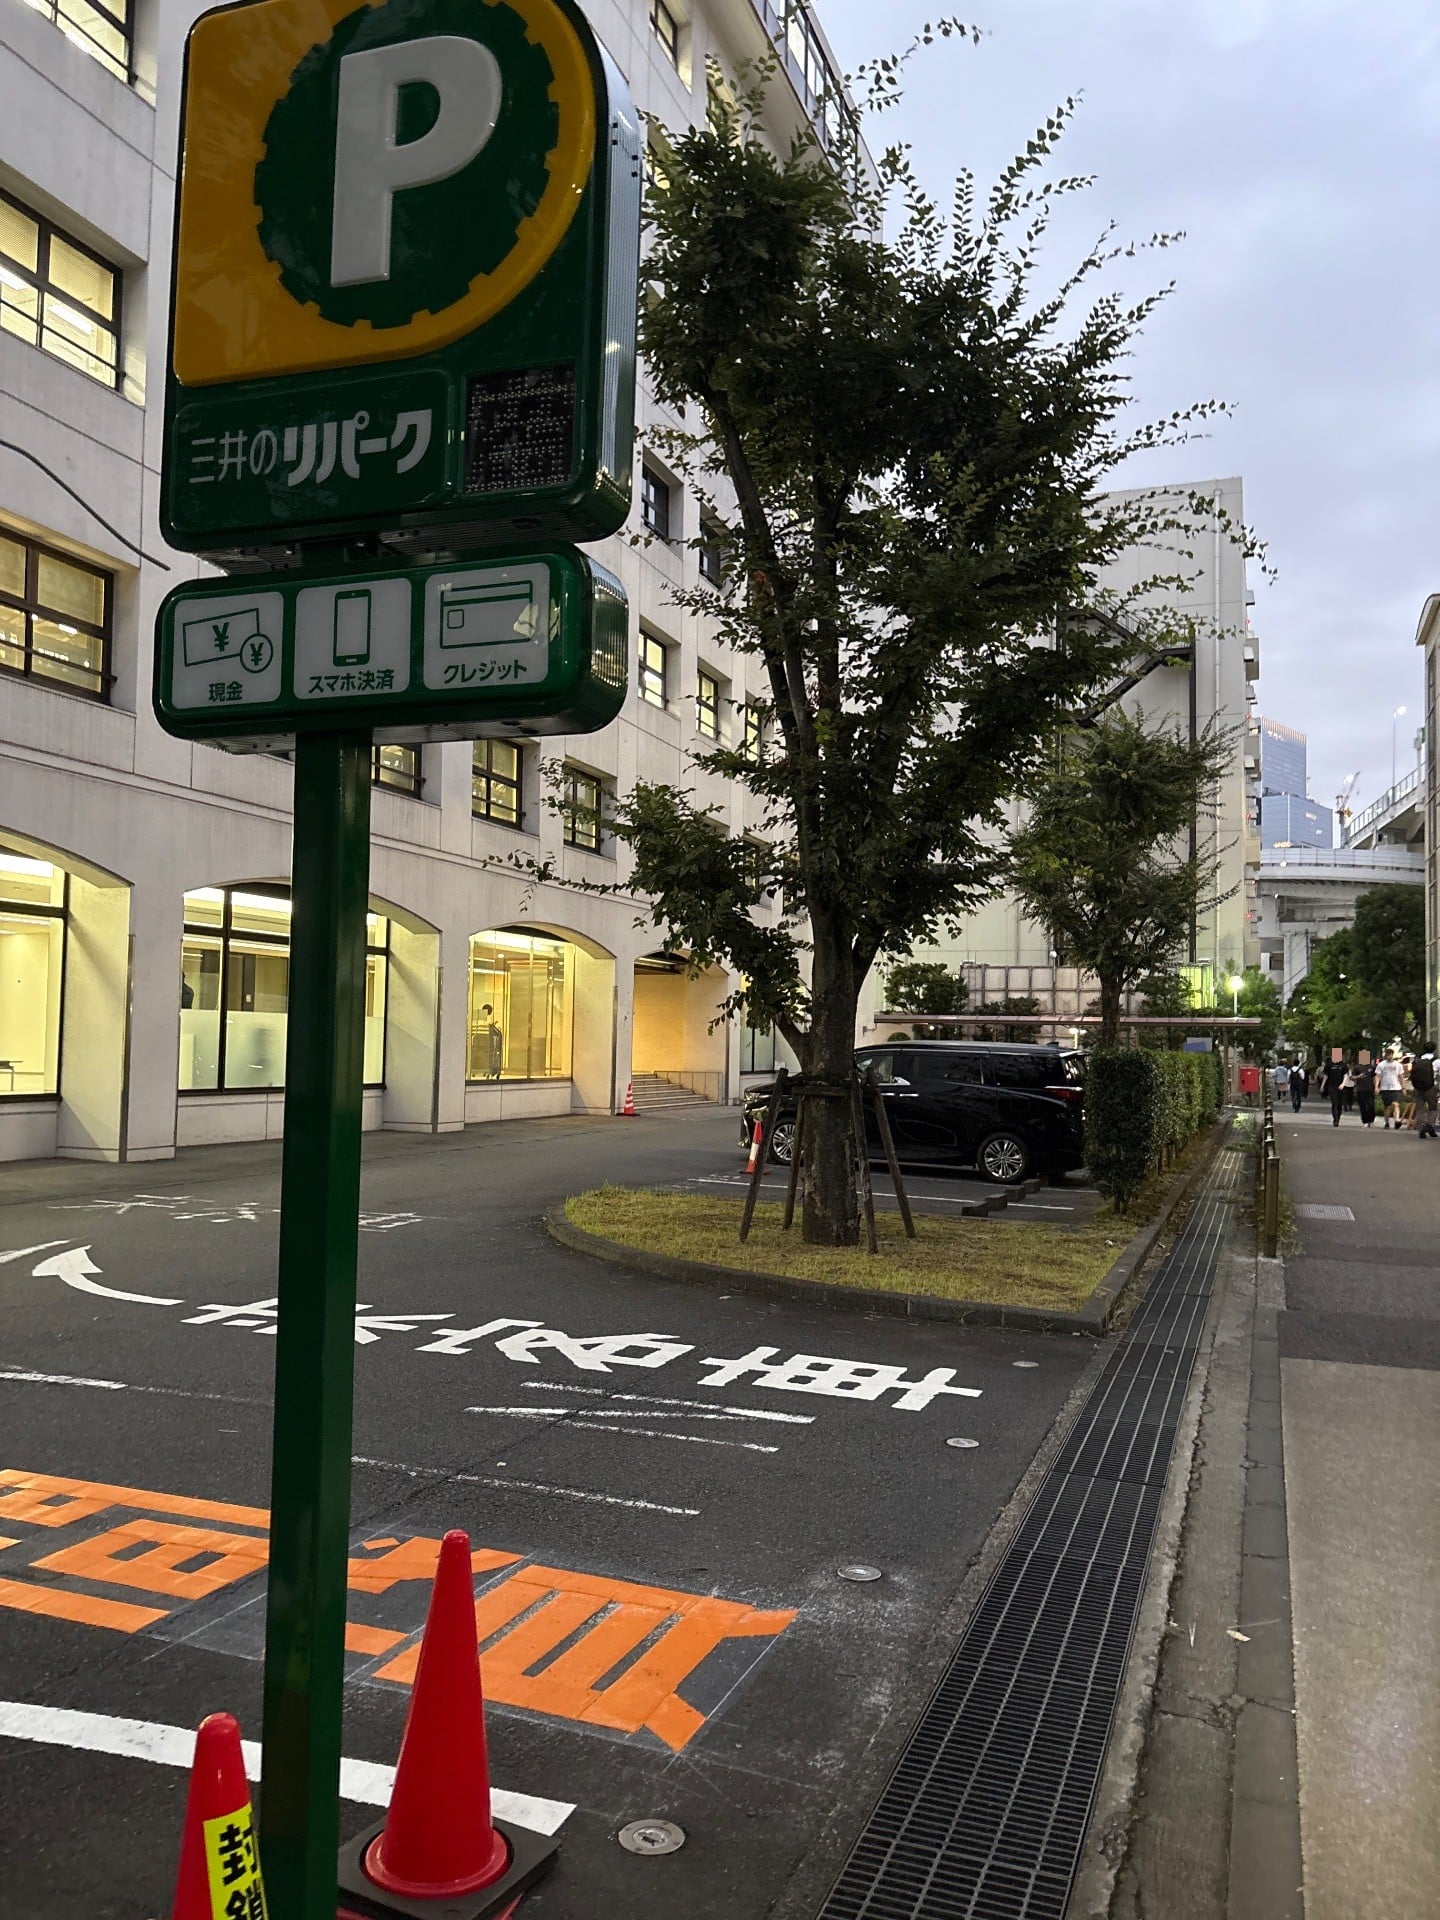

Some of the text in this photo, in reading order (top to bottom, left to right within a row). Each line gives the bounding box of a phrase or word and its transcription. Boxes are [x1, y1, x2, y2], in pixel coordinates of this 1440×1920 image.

[331, 35, 502, 287] P
[189, 409, 433, 487] 三井のリパーク
[308, 668, 395, 694] スマホ決済
[443, 659, 527, 684] クレジット
[208, 680, 243, 702] 現金
